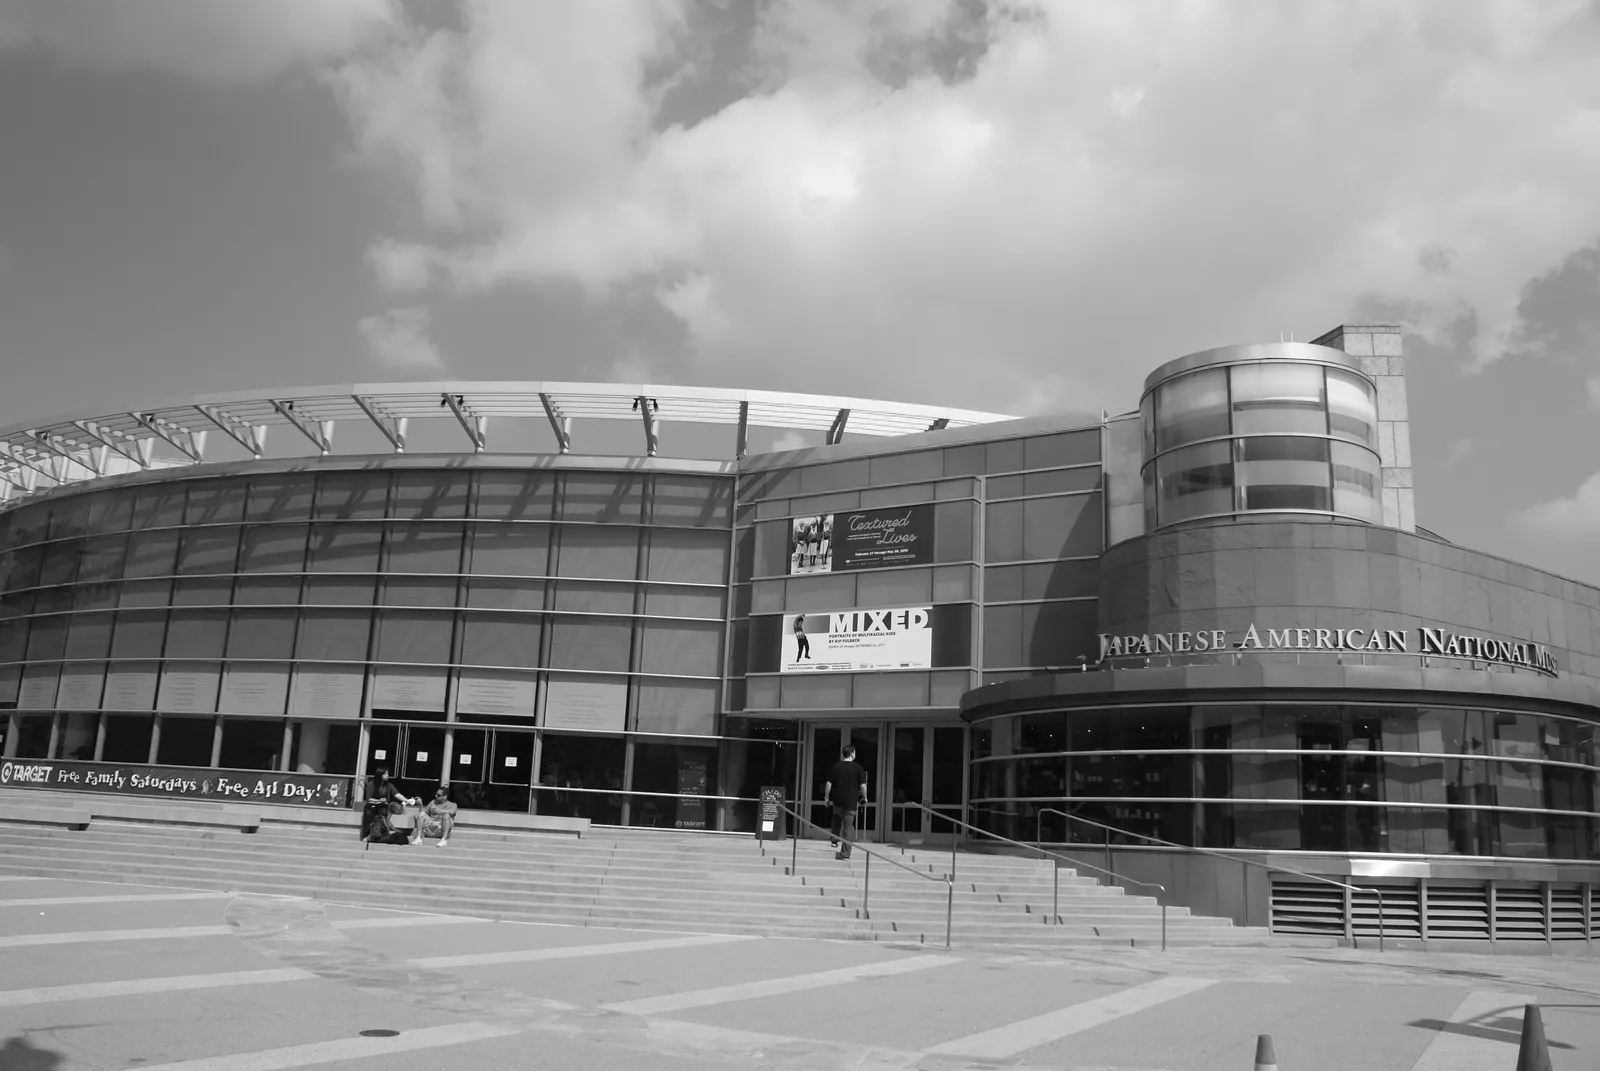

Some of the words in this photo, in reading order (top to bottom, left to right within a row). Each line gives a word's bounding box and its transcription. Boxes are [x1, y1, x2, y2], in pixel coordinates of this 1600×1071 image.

[848, 510, 912, 531] Textured
[876, 527, 917, 545] Lives
[829, 609, 929, 633] MIXED
[1095, 629, 1227, 664] JAPANESE
[1238, 622, 1408, 651] AMERICAN
[1420, 626, 1531, 664] NATIONAL
[13, 765, 53, 783] TARGET
[57, 769, 80, 784] Free
[85, 770, 126, 789] Family
[130, 773, 197, 793] Saturdays
[216, 778, 249, 797] Free
[252, 780, 278, 798] All
[282, 783, 321, 801] Day!
